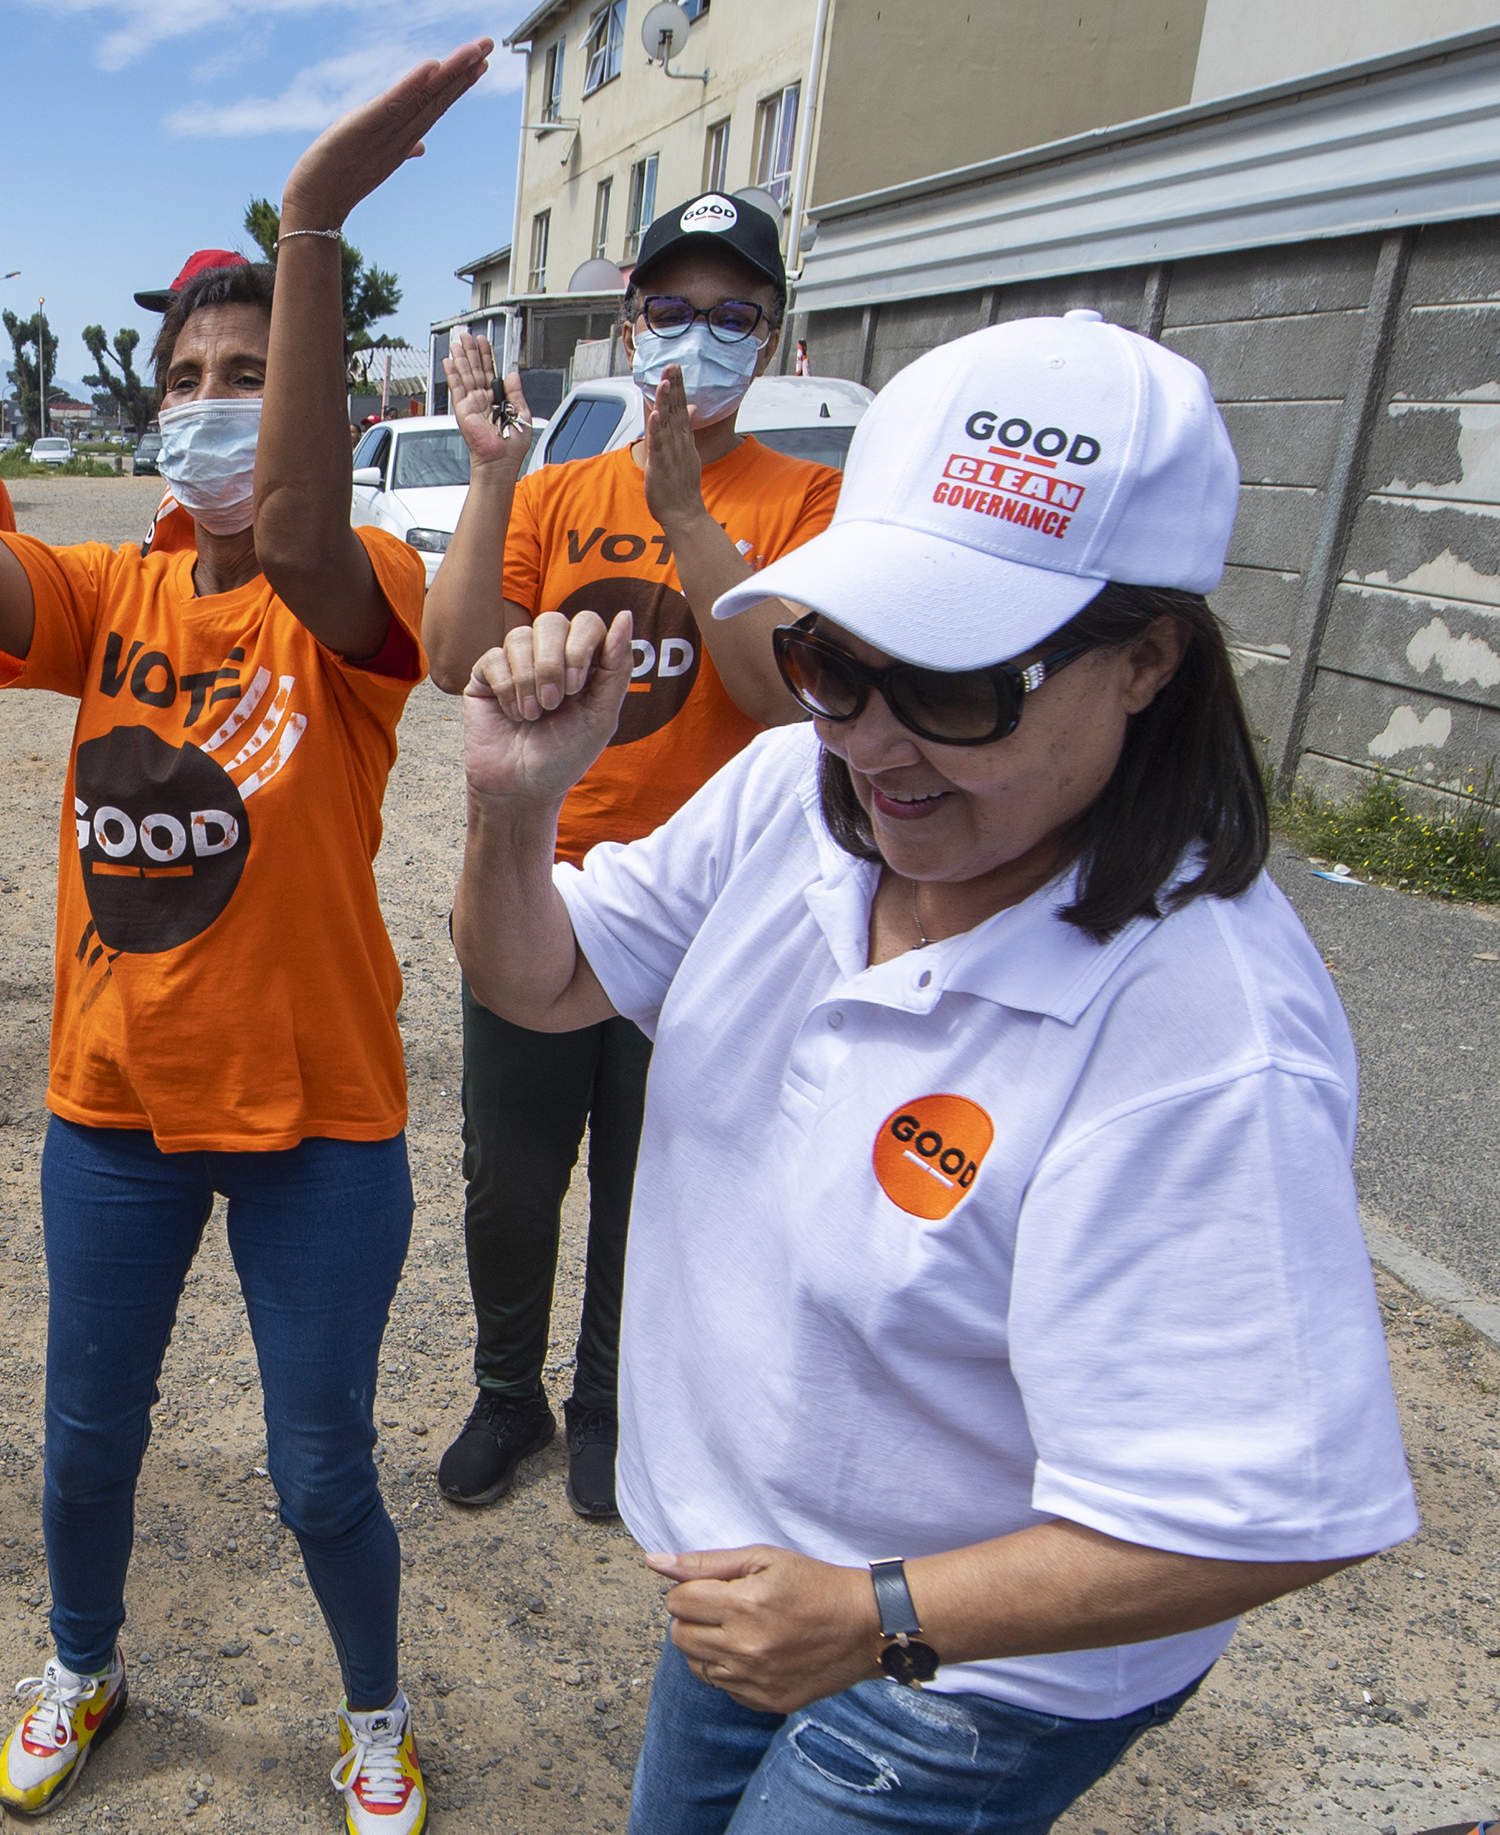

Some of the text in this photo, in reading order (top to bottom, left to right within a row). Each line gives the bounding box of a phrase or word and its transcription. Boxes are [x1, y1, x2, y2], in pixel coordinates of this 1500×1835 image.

[684, 205, 735, 221] GOOD
[965, 410, 1101, 466] GOOD
[932, 481, 1072, 540] GOVERNANCE
[947, 456, 1082, 510] CLEAN
[567, 526, 674, 566] VOT
[99, 631, 246, 728] VOTE
[631, 637, 694, 678] OD
[891, 1114, 977, 1189] GOOD
